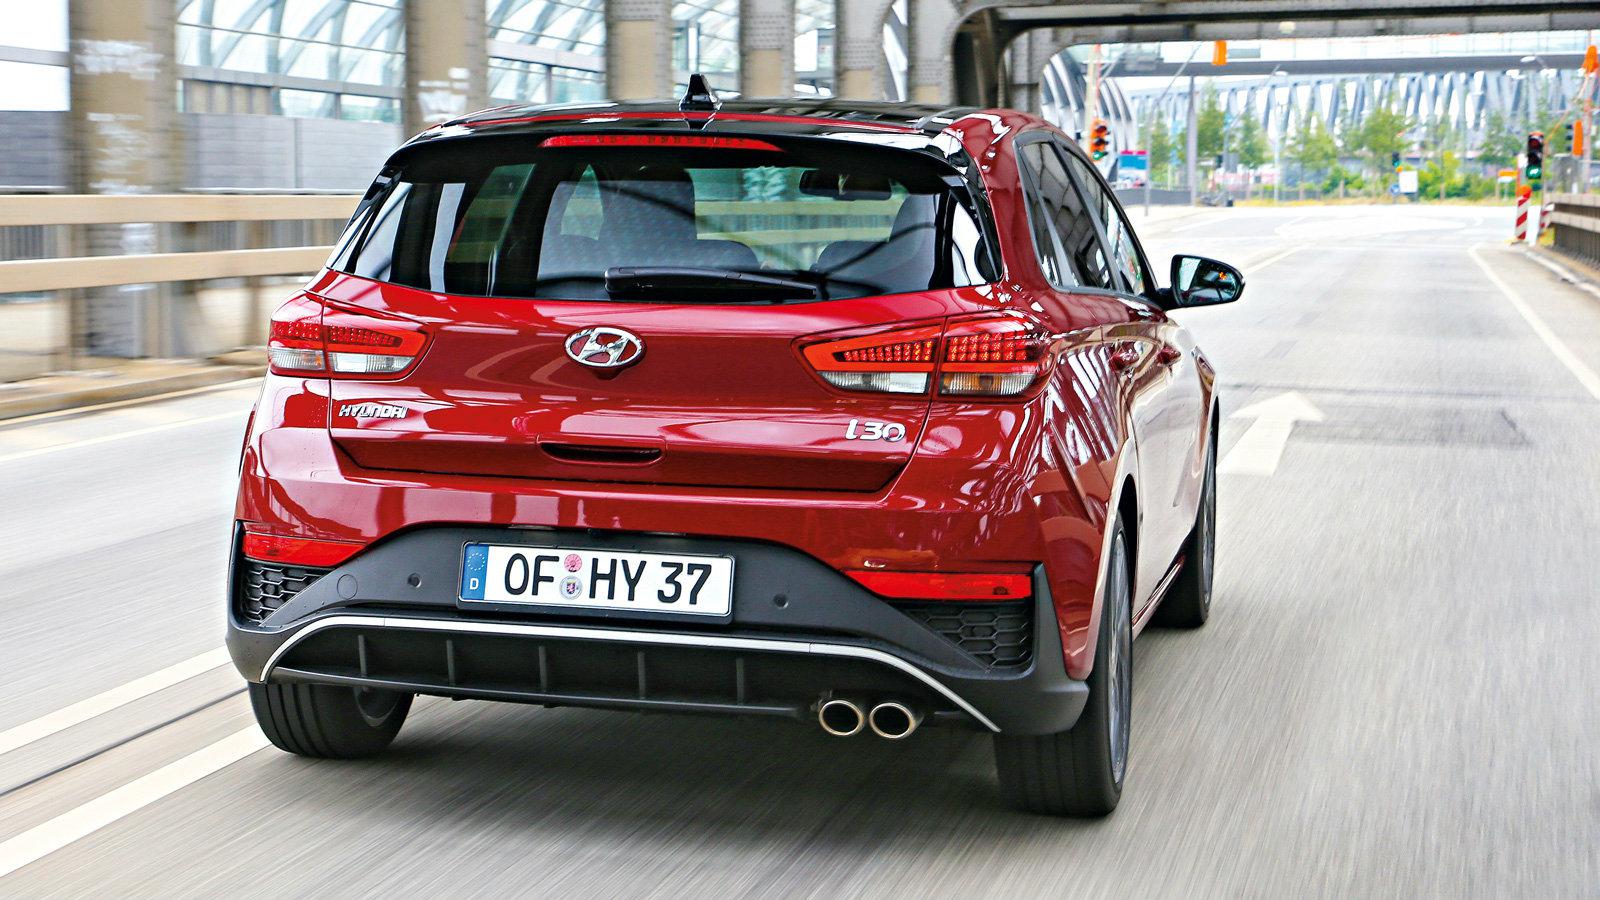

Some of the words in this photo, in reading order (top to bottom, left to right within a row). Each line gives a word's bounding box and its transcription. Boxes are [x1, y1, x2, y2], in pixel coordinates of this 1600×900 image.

[338, 404, 409, 419] HYUNDAI
[469, 577, 479, 590] D
[504, 552, 560, 596] OF
[589, 557, 647, 601] HY
[657, 561, 712, 605] 37
